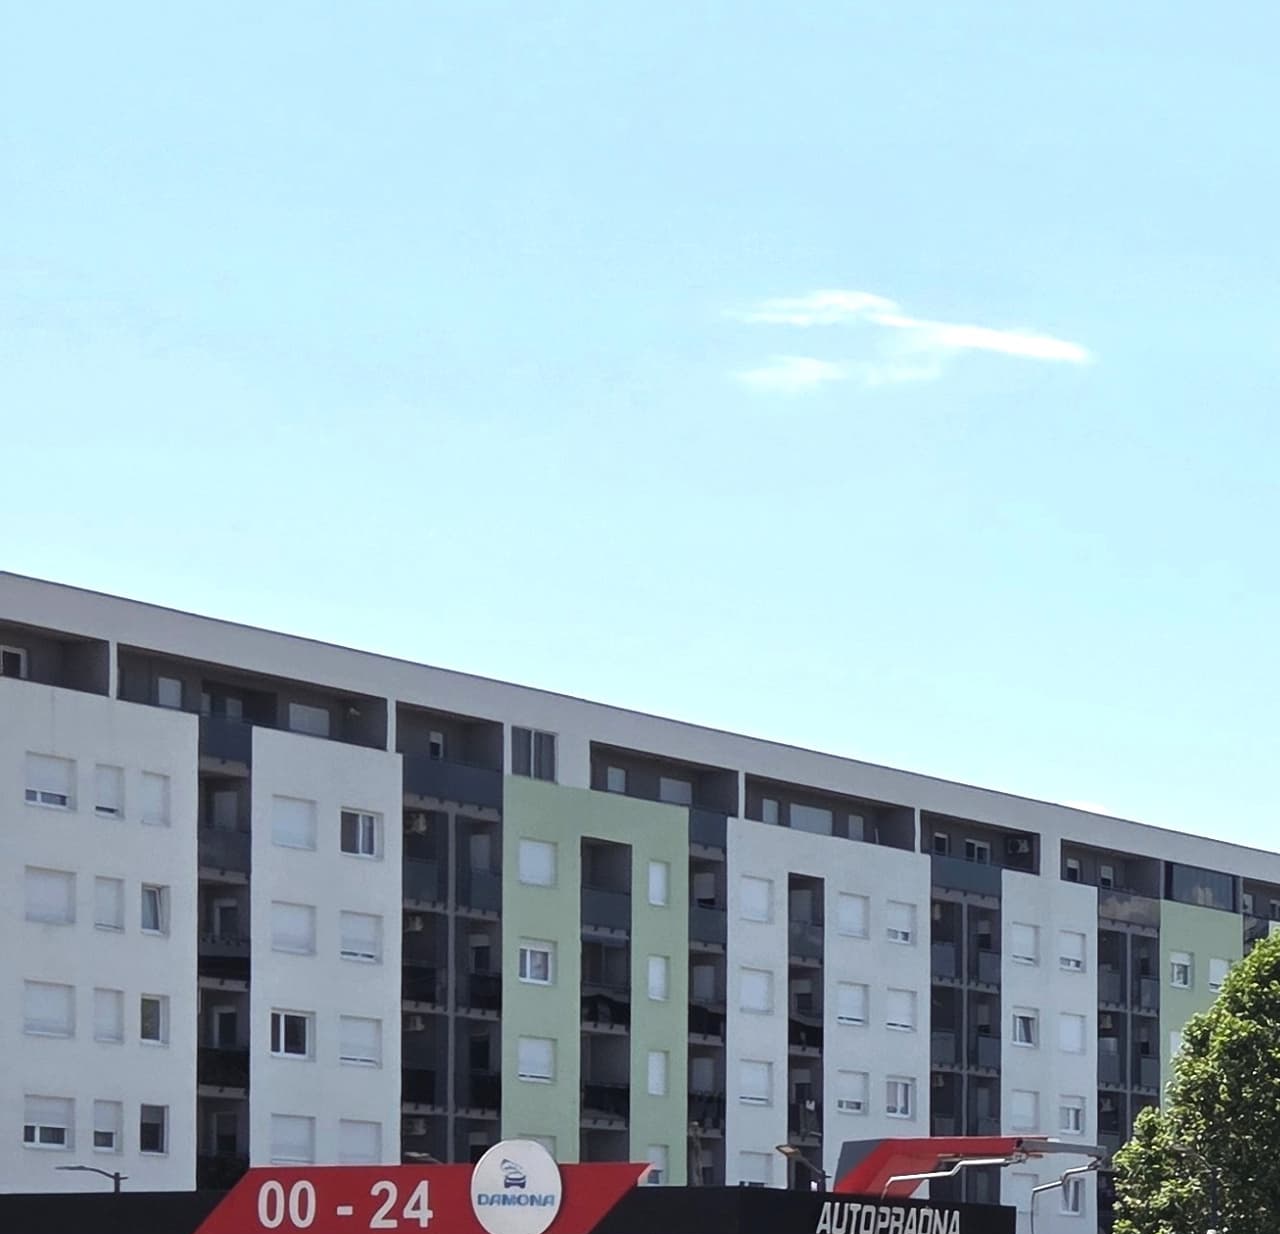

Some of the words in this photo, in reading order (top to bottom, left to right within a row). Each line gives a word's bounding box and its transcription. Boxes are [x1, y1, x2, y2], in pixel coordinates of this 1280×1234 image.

[258, 1180, 316, 1228] 00
[369, 1180, 433, 1229] 24
[477, 1193, 555, 1207] DAMONA
